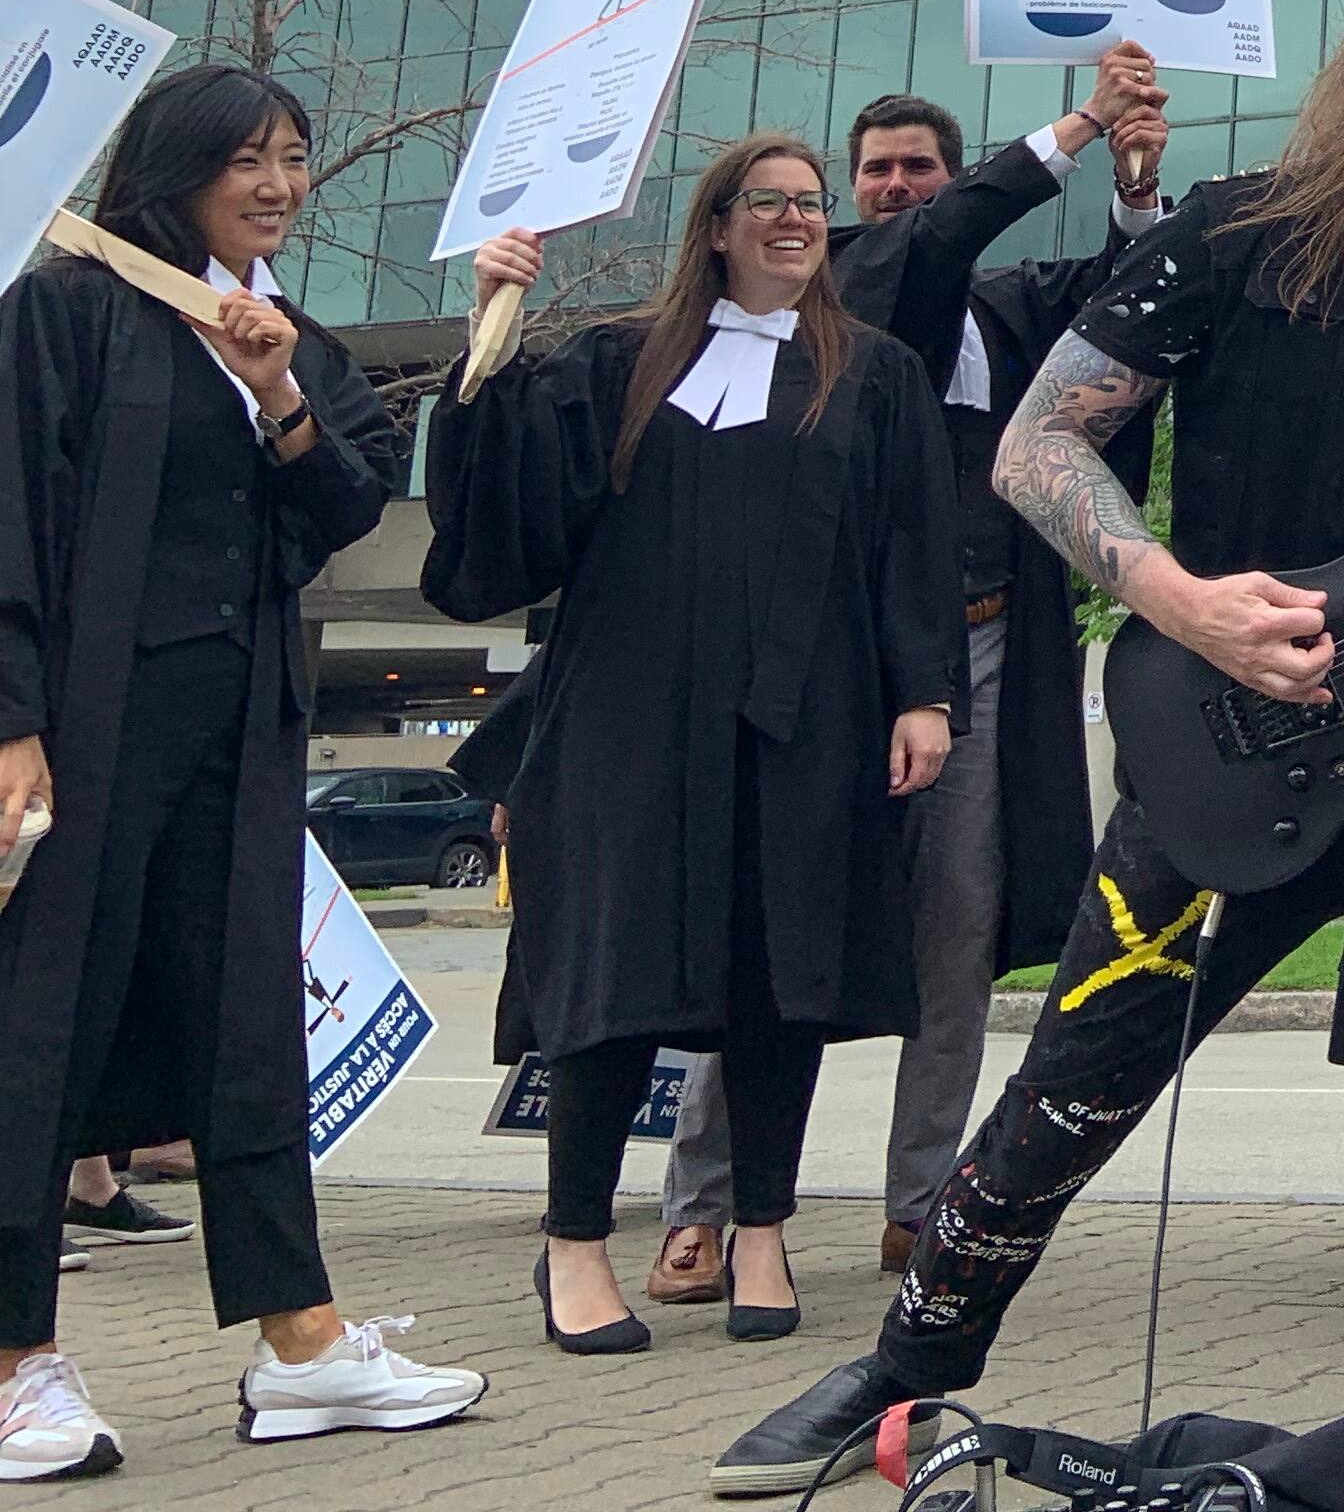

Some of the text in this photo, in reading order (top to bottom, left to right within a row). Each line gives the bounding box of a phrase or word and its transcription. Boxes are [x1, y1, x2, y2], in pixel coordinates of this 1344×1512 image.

[71, 22, 107, 69] AQAAD
[90, 28, 121, 68] AADM
[104, 36, 134, 75] AADQ
[118, 43, 146, 82] AADO
[374, 992, 409, 1039] ACCÈS
[349, 1043, 370, 1066] LA
[308, 1062, 351, 1115] JUSTIC
[309, 1050, 396, 1143] VÉRITABLE
[1059, 1453, 1117, 1486] Roland
